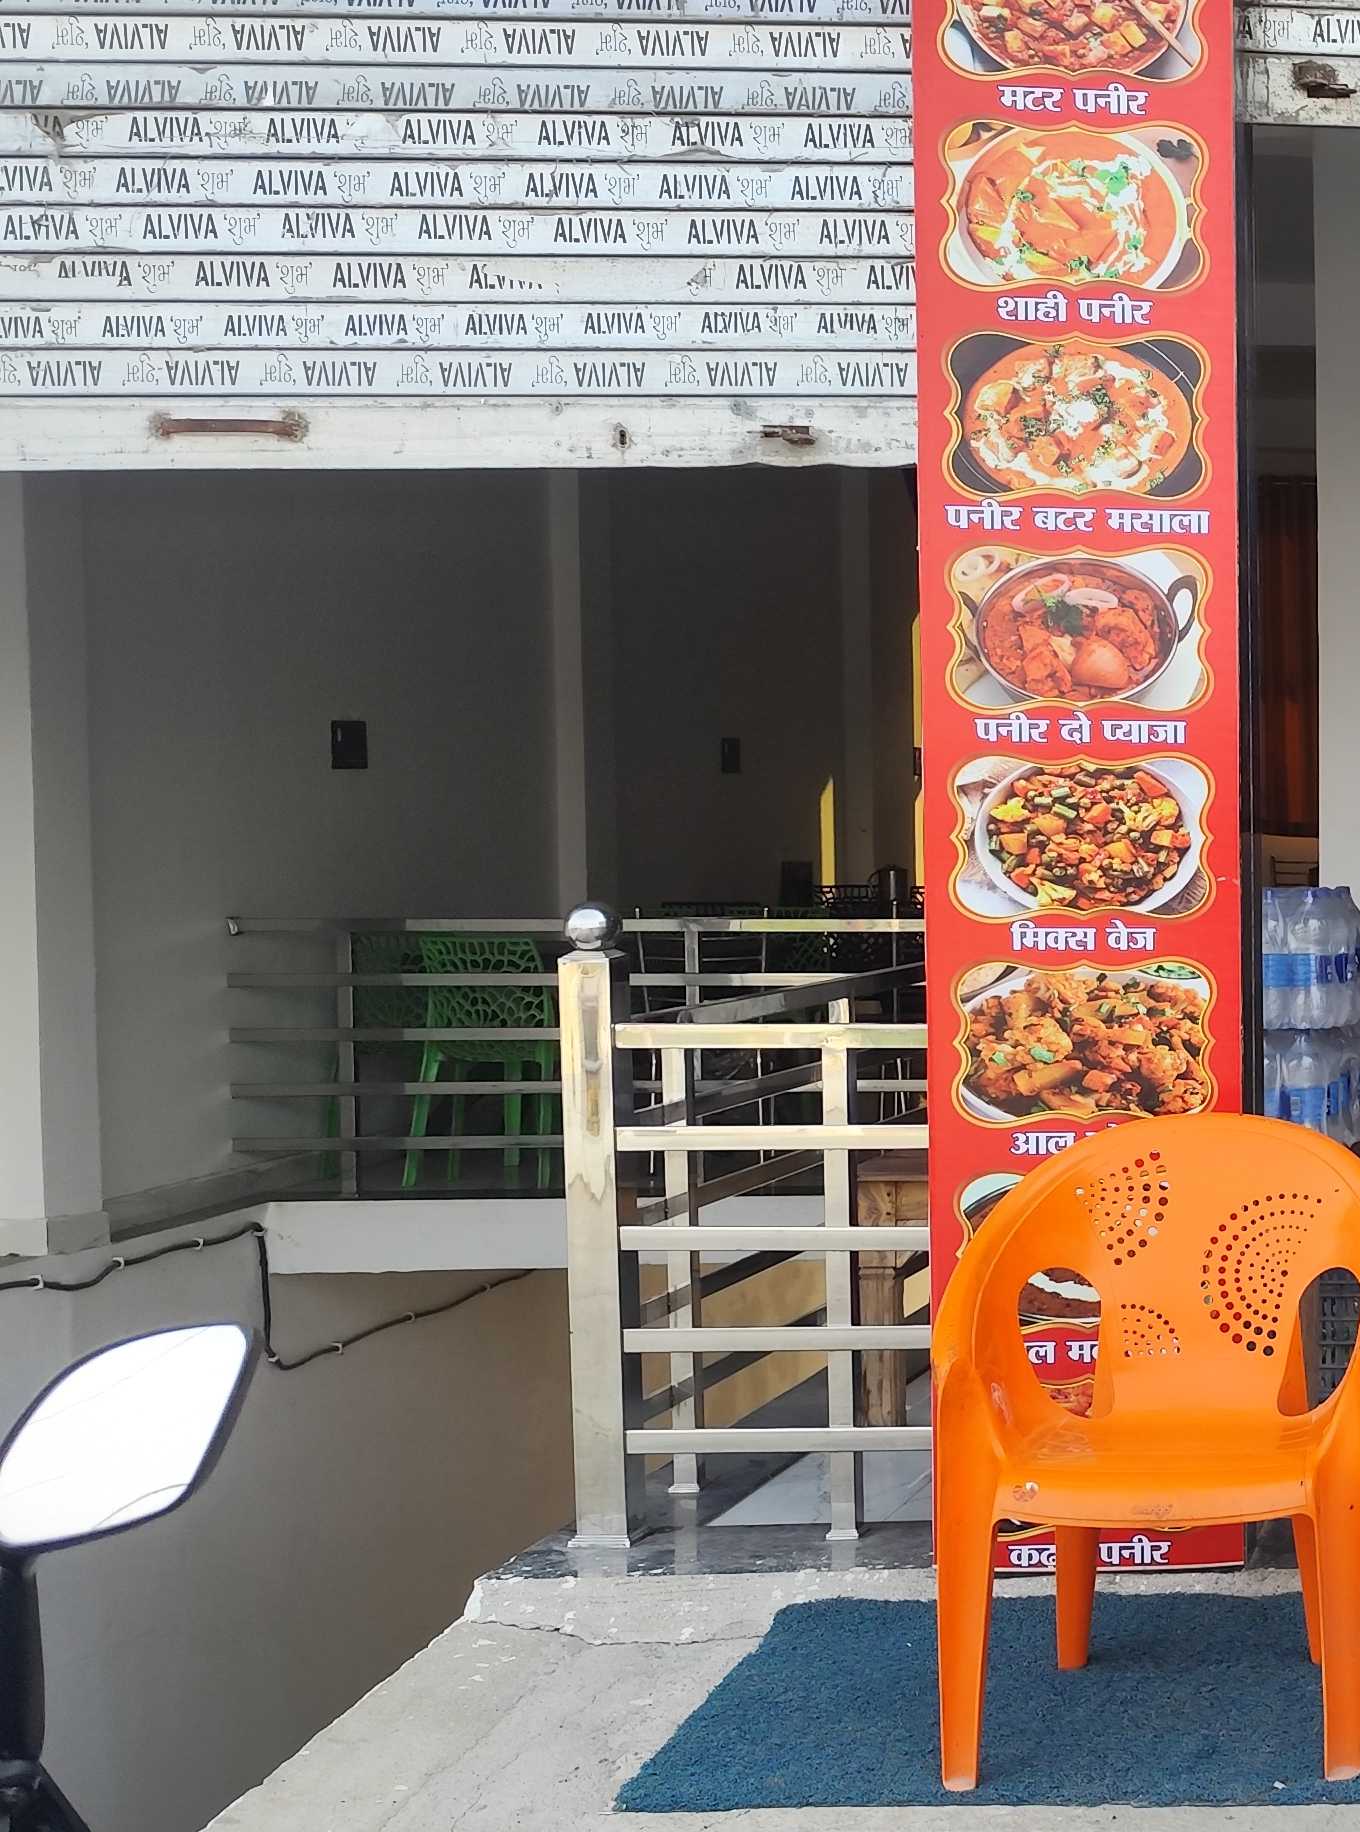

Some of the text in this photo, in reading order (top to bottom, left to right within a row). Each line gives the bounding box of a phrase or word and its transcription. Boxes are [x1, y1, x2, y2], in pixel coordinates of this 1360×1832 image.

[998, 83, 1148, 116] मटर पनीर
[116, 167, 190, 194] ALVIVA
[253, 169, 327, 196] ALVIVA
[390, 171, 463, 197] ALVIVA
[526, 172, 598, 199] ALVIVA
[659, 174, 730, 199] ALVIVA
[791, 175, 862, 201] ALVIVA
[143, 214, 217, 240] ALVIVA
[281, 213, 355, 239] ALVIVA
[418, 214, 492, 240] ALVIVA
[554, 217, 627, 244] ALVIVA
[688, 219, 759, 244] ALVIVA
[819, 219, 890, 244] ALVIVA
[997, 289, 1153, 325] शाही पनीर
[945, 498, 1210, 534] पनीर बटर मसाला
[974, 712, 1186, 744] पनीर दो प्याजा
[1010, 920, 1156, 953] मिक्स वेज
[1098, 1534, 1172, 1565] पनीर
